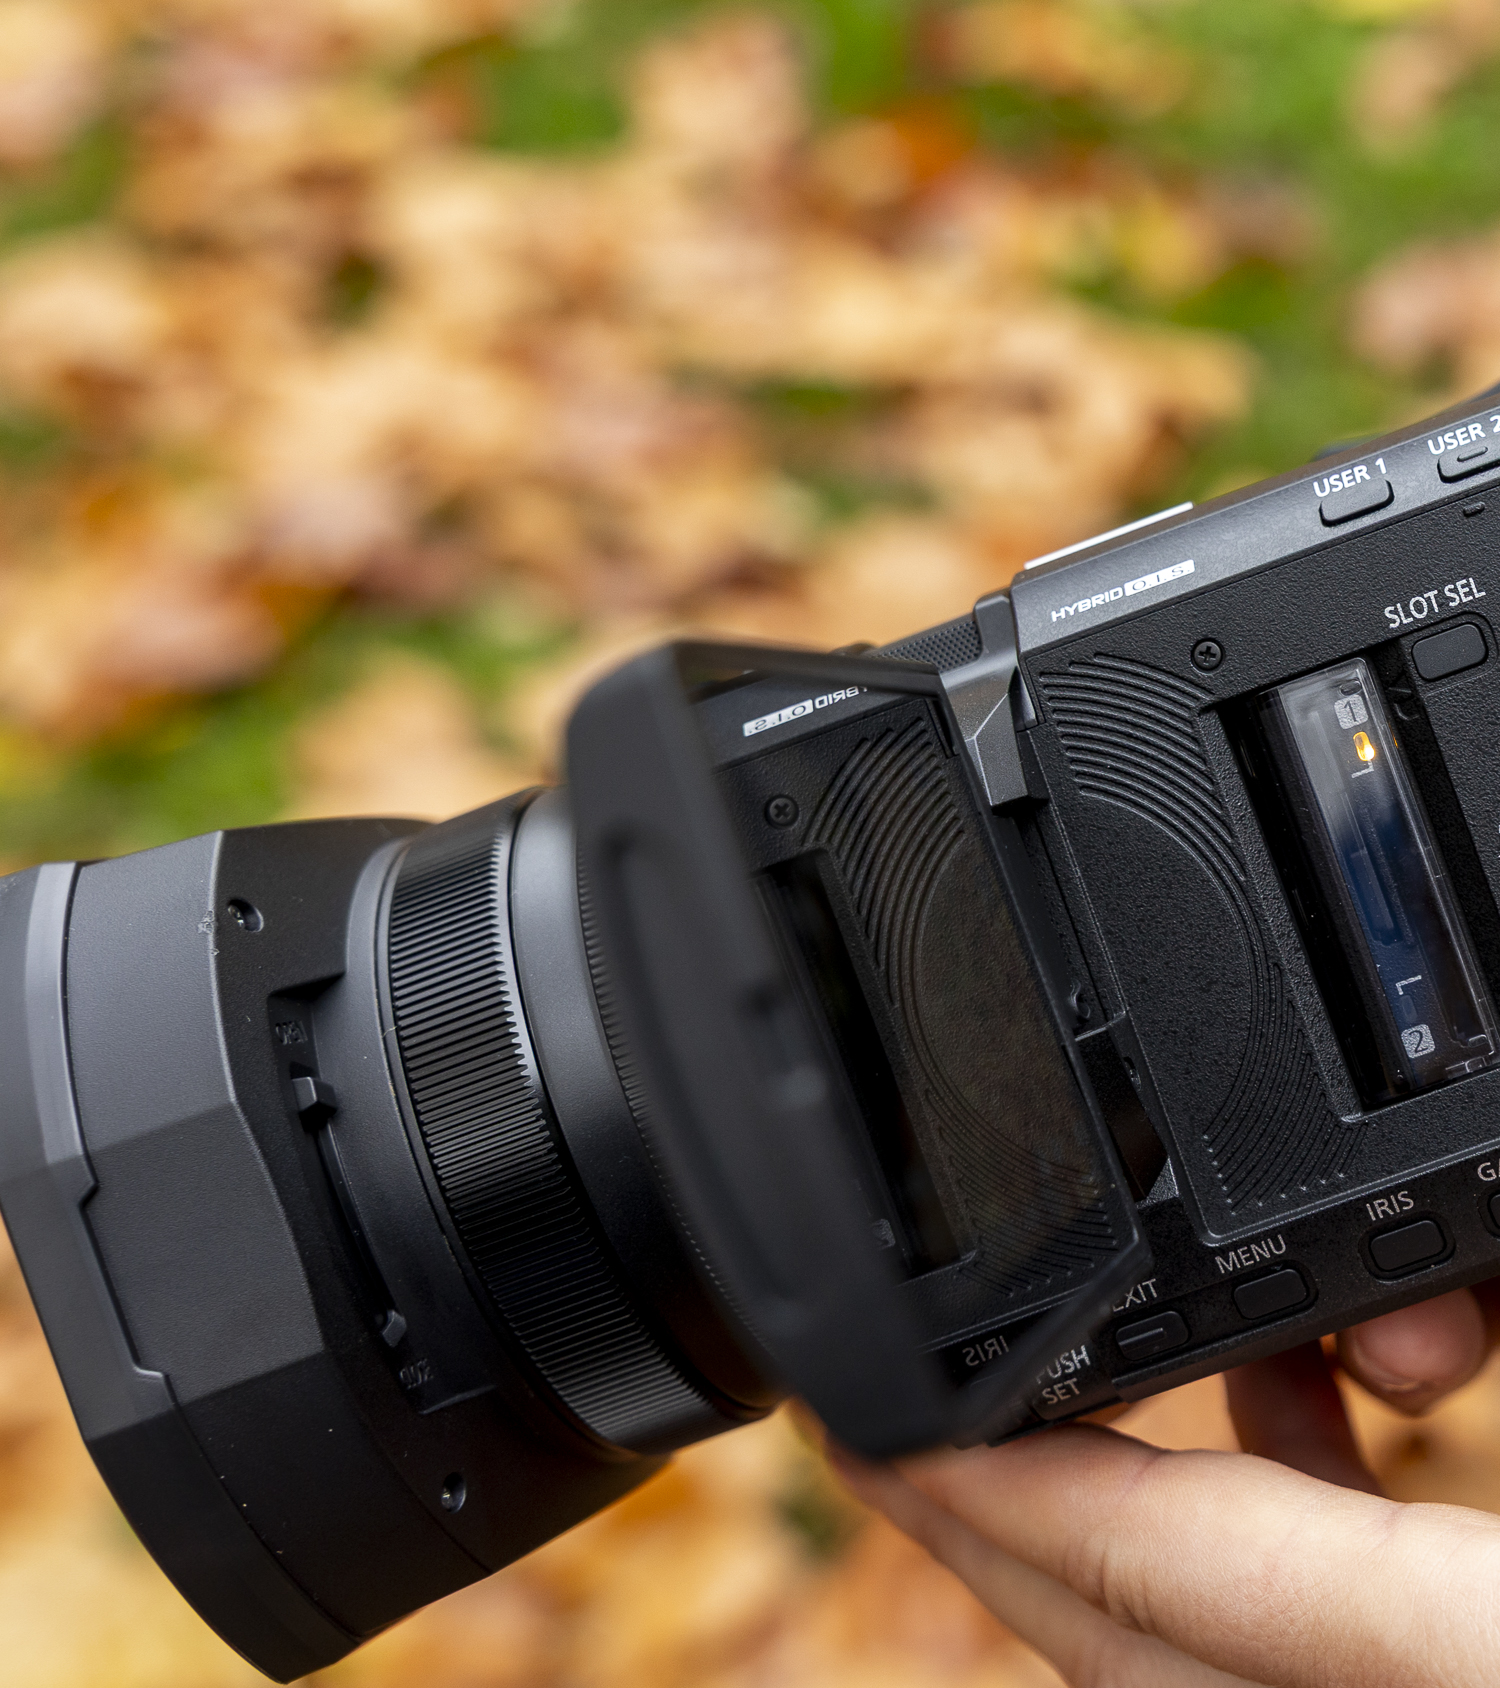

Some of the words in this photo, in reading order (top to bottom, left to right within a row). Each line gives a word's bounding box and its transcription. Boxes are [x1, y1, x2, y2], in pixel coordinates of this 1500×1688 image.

[1427, 423, 1487, 456] USER
[1312, 466, 1372, 498] USER
[1374, 456, 1388, 476] 1
[1050, 586, 1124, 623] HYBRID
[1383, 591, 1439, 629] SLOT
[1443, 576, 1487, 606] SEL
[1342, 699, 1359, 724] 1
[1408, 1028, 1427, 1054] 2
[1364, 1189, 1415, 1222] IRIS
[1214, 1233, 1288, 1275] MENU
[1040, 1376, 1082, 1406] SET
